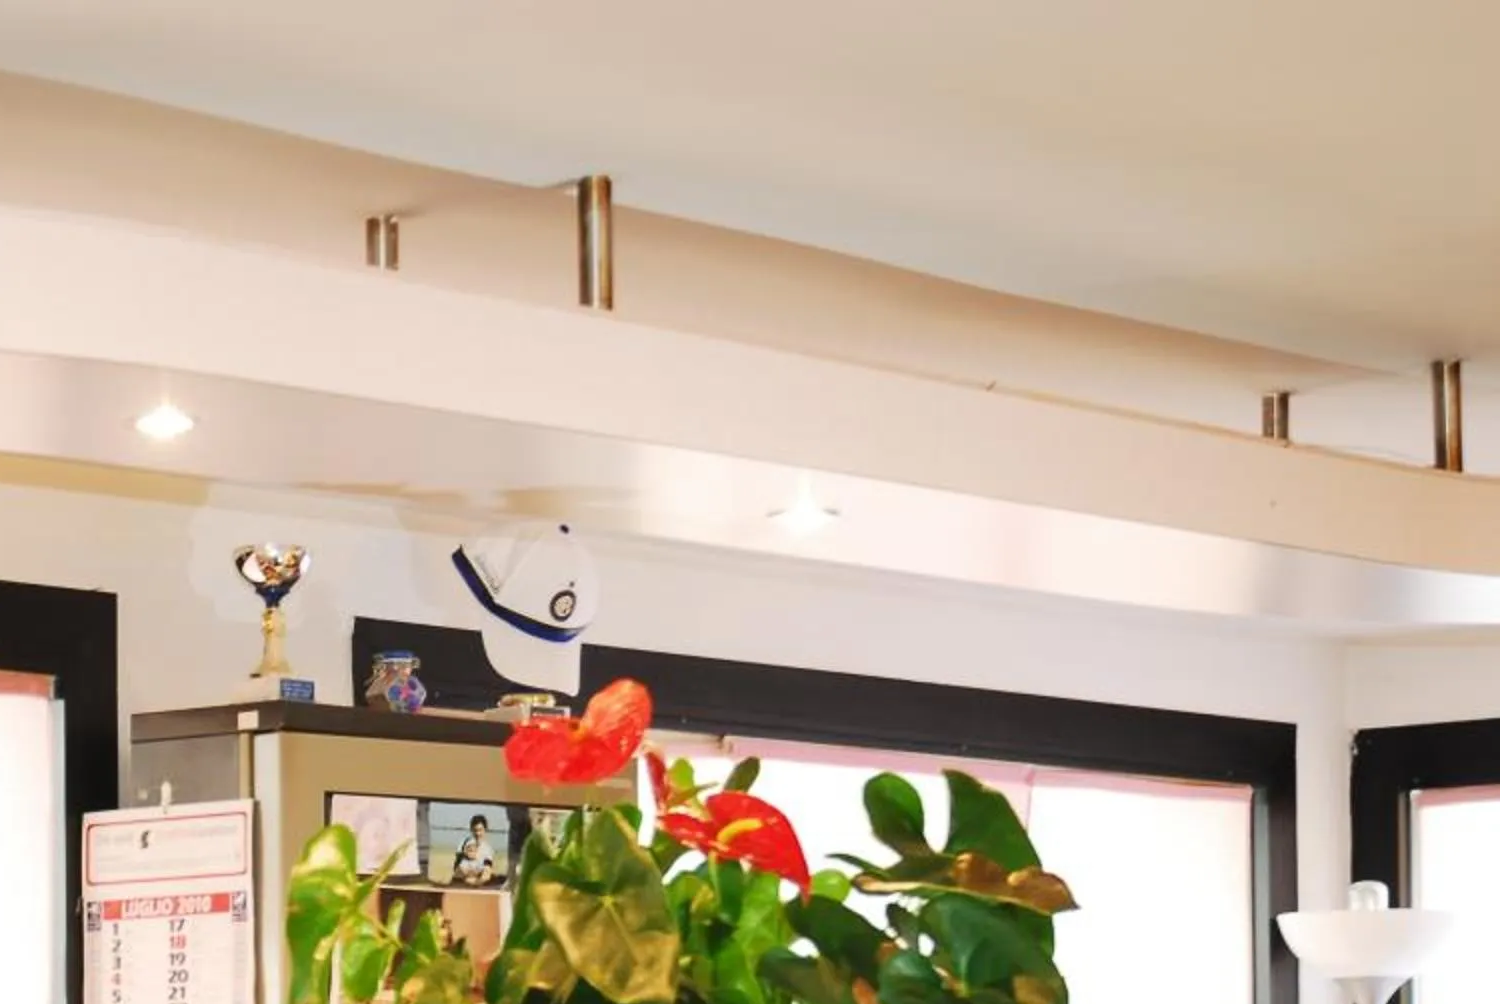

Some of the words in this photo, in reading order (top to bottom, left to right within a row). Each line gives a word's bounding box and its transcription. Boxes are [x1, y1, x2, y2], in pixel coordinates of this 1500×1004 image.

[121, 897, 173, 918] LUGLIO
[112, 922, 119, 936] 1
[169, 919, 185, 932] 17
[112, 939, 122, 953] 2
[169, 936, 187, 949] 18
[112, 956, 122, 970] 3
[169, 952, 187, 966] 19
[112, 973, 121, 985] 4
[168, 969, 189, 983] 20
[112, 990, 122, 1003] 5
[168, 986, 186, 1000] 21
